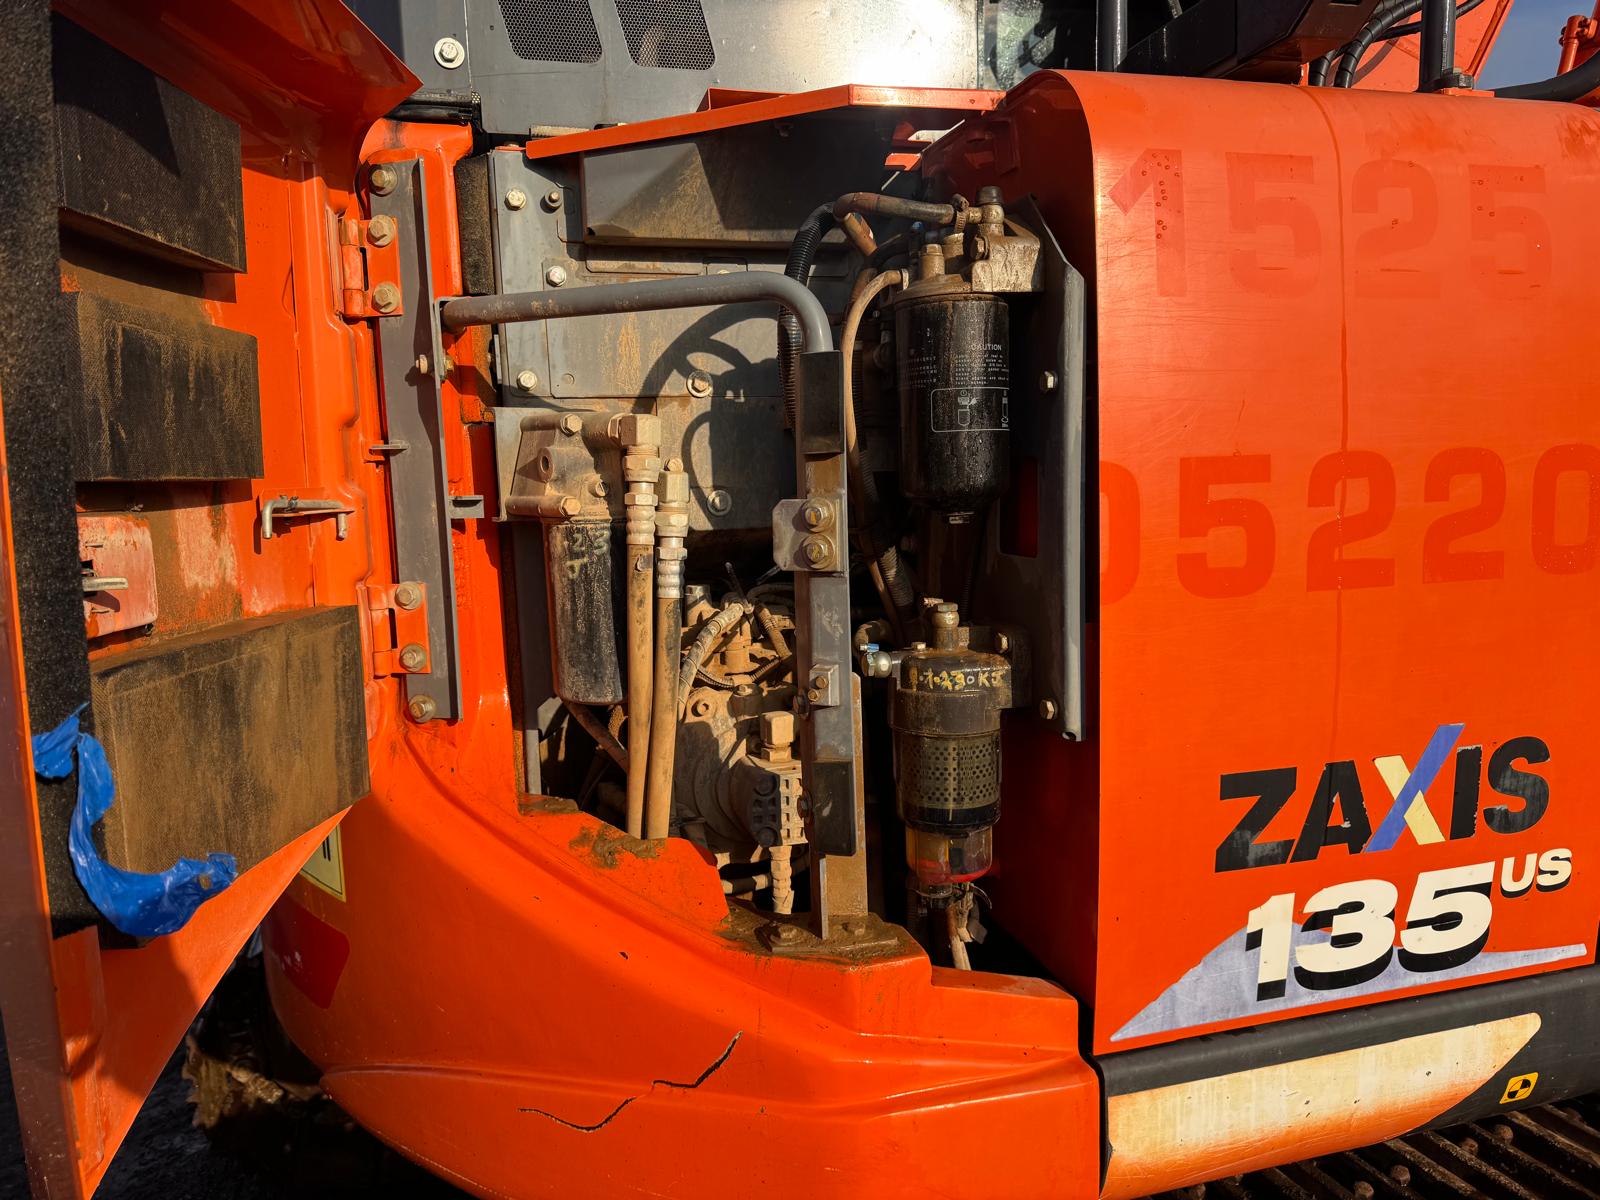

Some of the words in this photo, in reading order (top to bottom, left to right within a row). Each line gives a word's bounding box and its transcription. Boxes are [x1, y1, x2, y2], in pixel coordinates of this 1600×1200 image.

[1108, 148, 1552, 300] 1525
[971, 344, 1002, 352] CAUTION
[1215, 723, 1551, 873] ZAXIS
[1245, 861, 1496, 1001] 135
[1500, 848, 1573, 898] US
